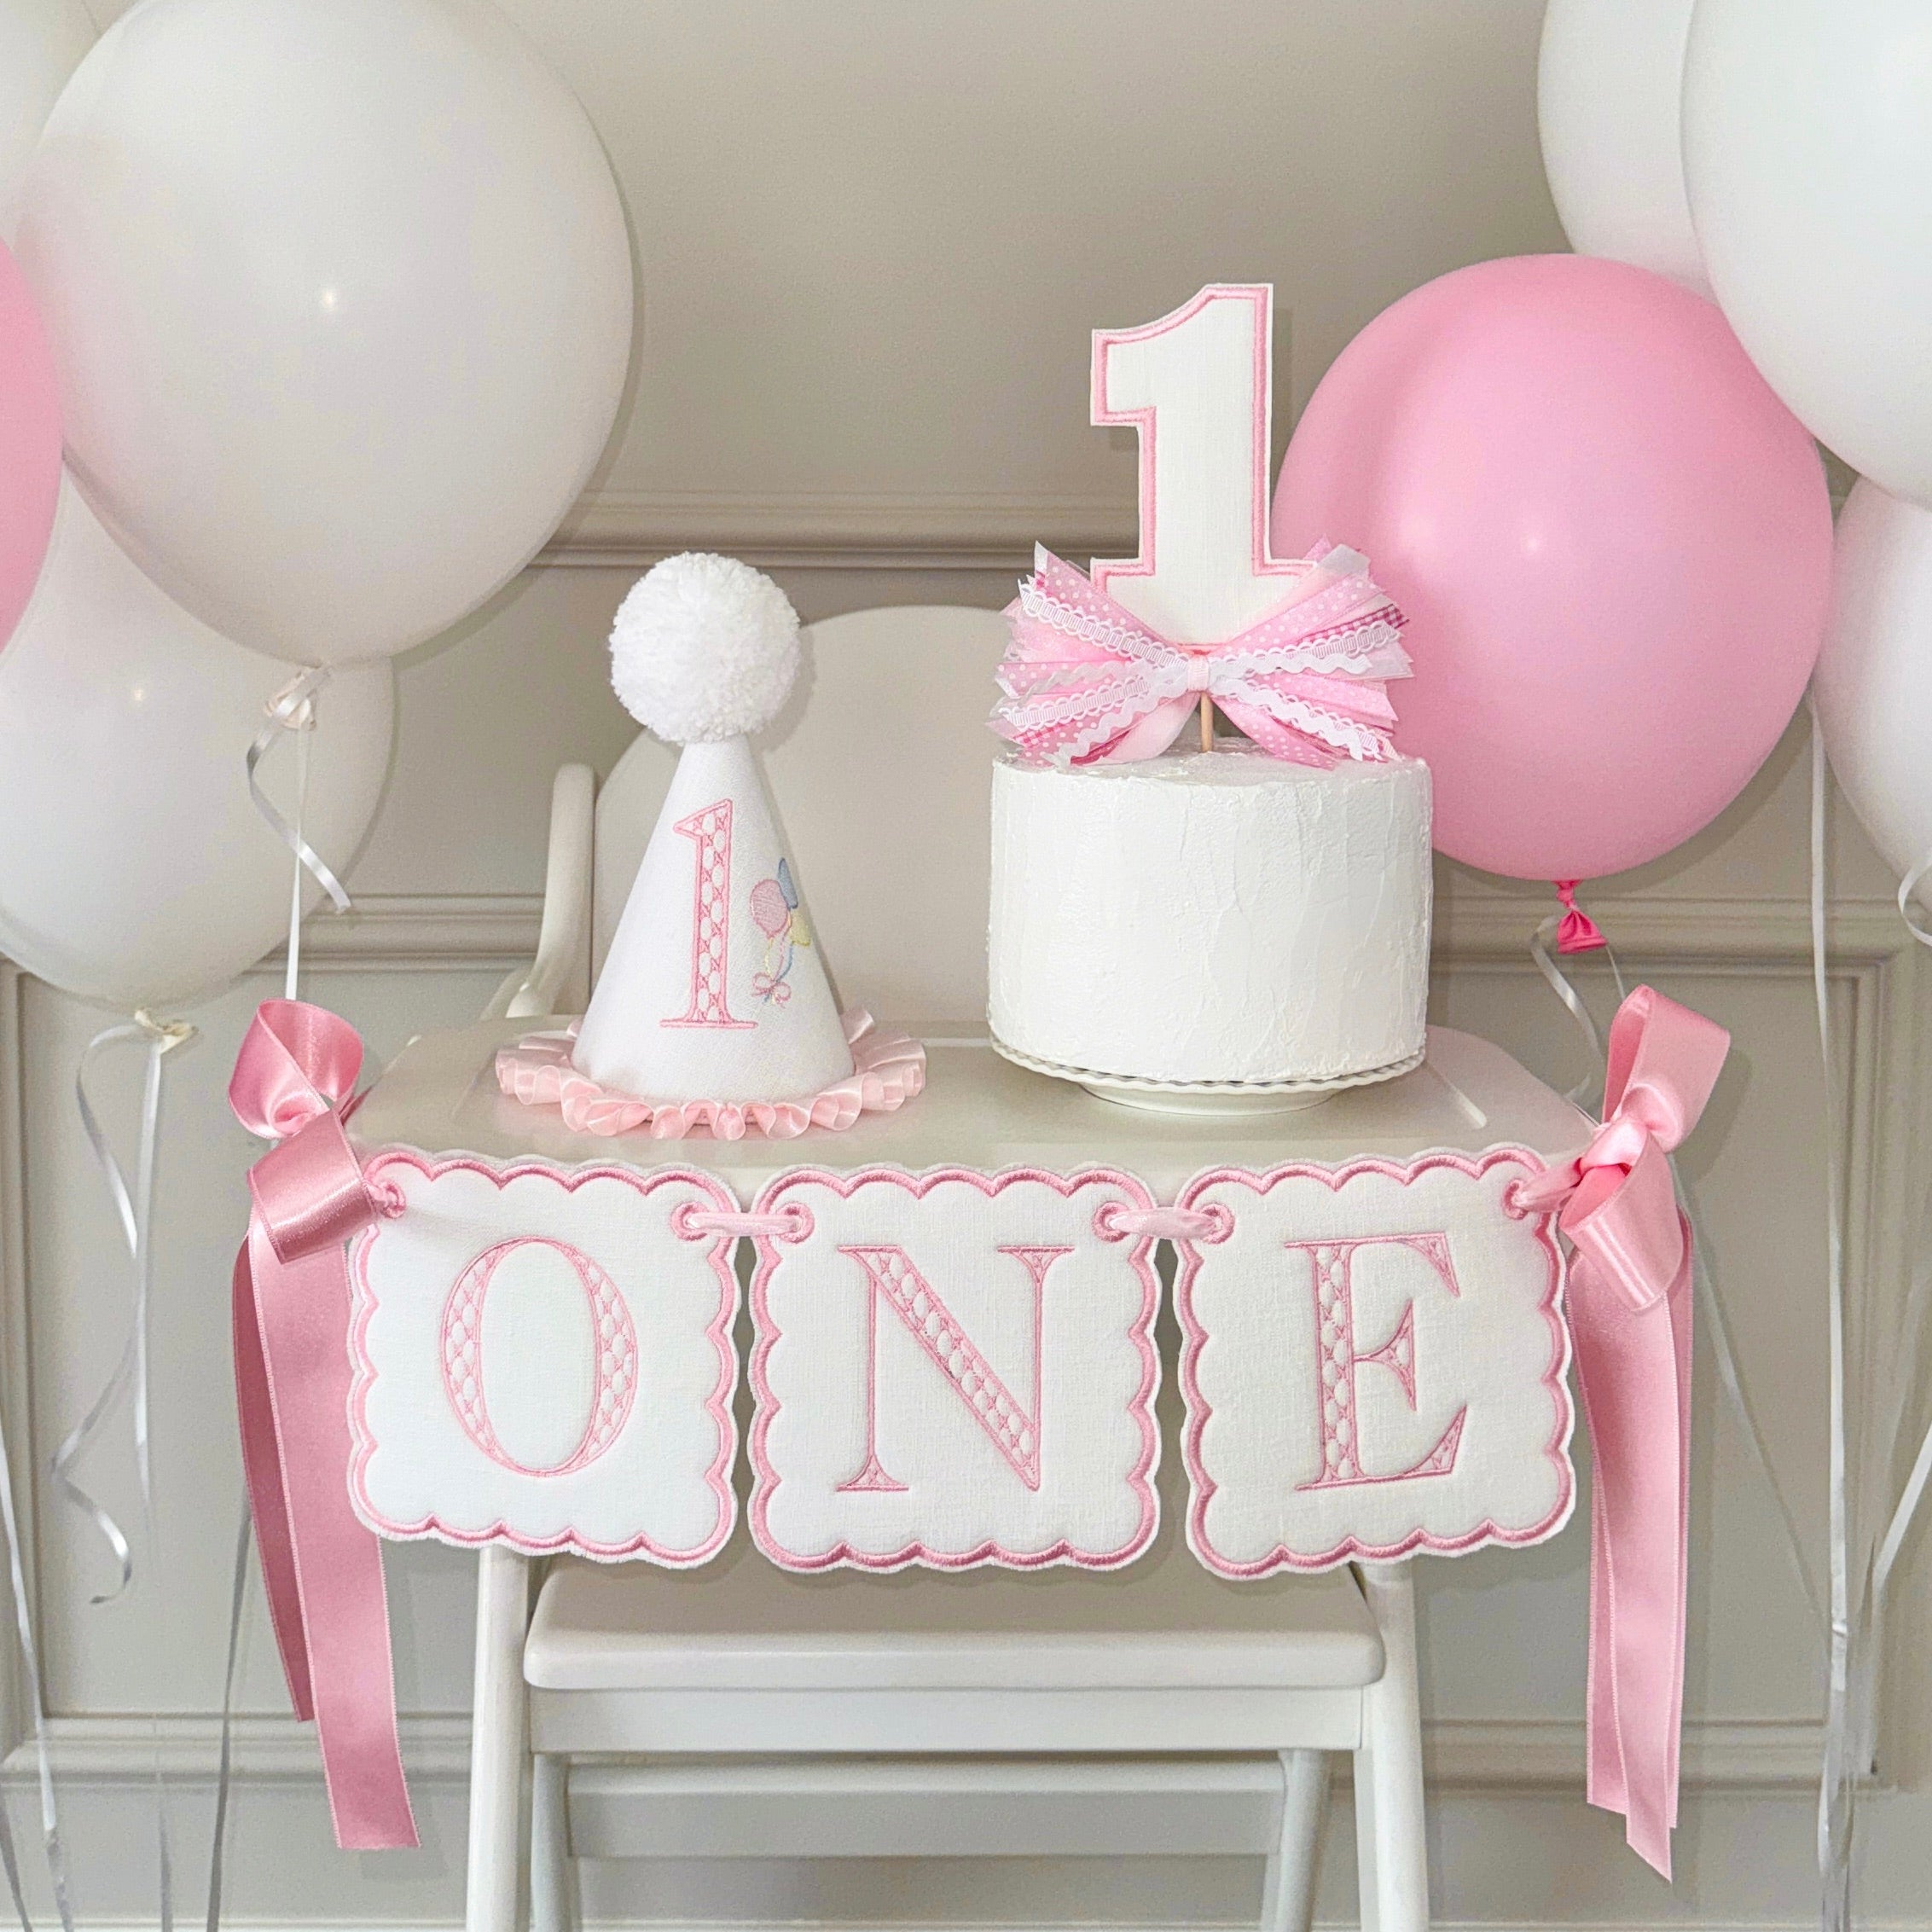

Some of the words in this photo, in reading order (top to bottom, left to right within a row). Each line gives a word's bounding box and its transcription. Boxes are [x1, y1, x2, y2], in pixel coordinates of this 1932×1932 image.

[1090, 282, 1317, 652] 1
[659, 798, 758, 1030] 1
[439, 1232, 1468, 1493] ONE
